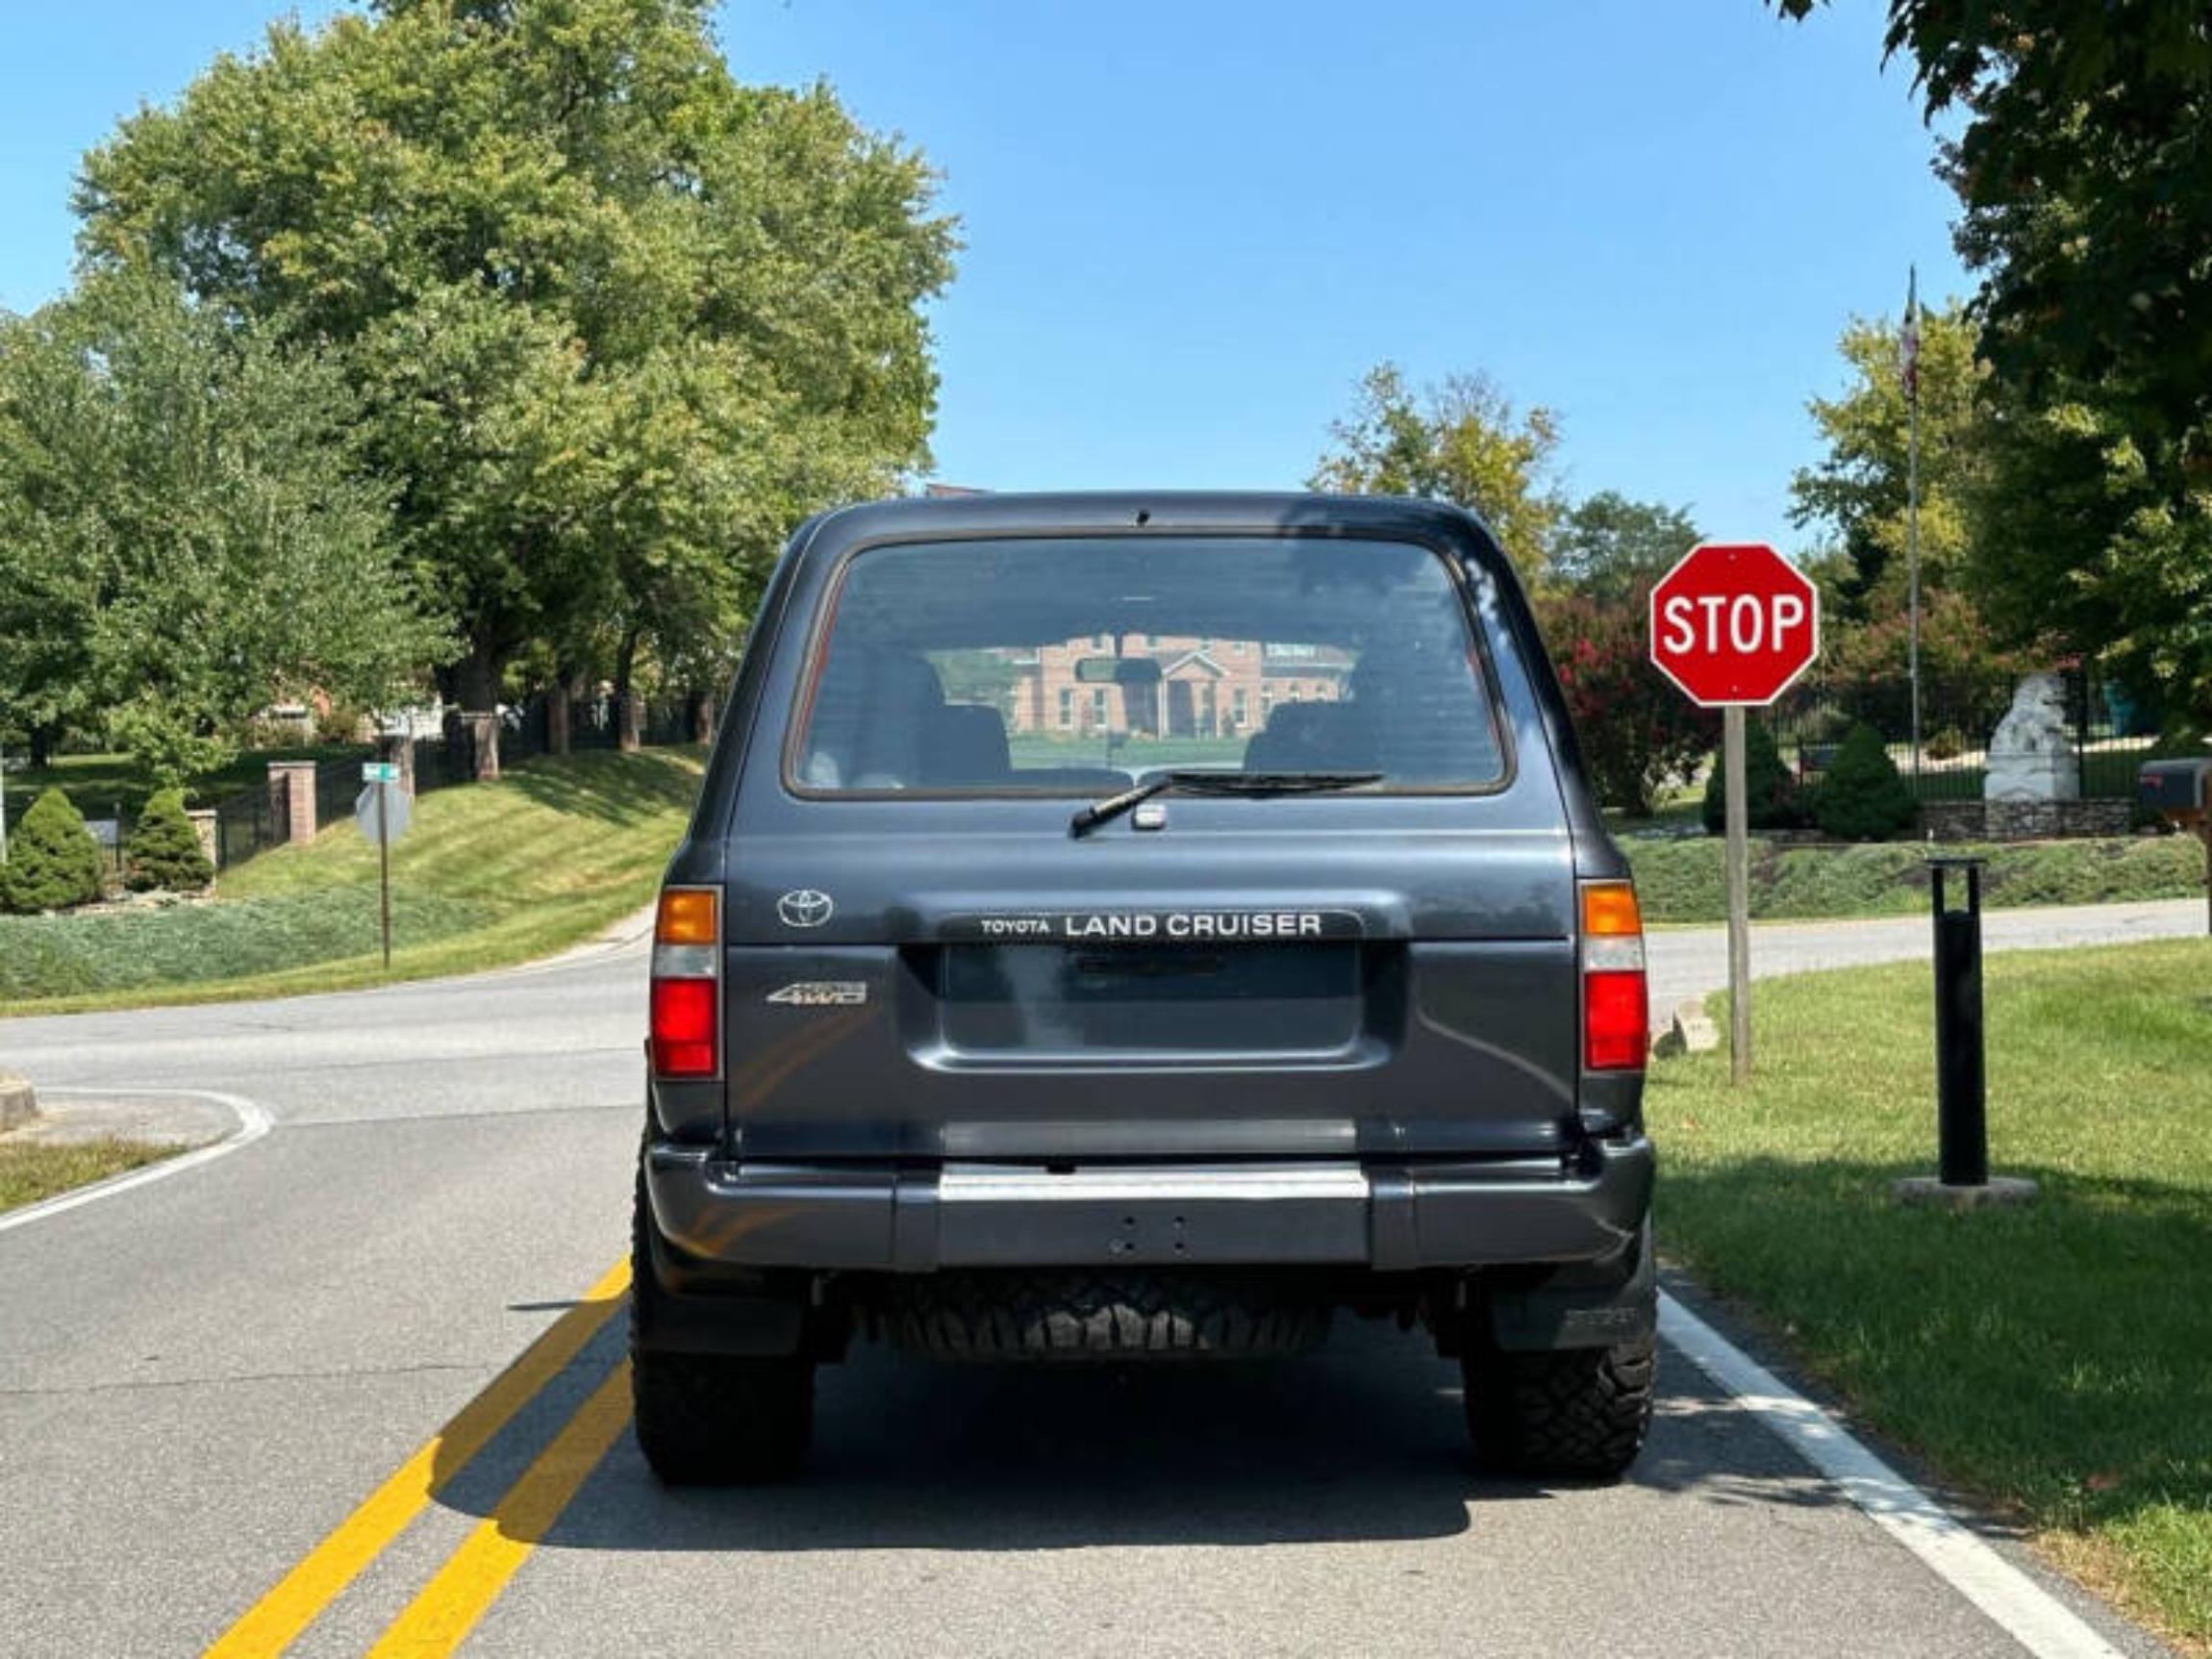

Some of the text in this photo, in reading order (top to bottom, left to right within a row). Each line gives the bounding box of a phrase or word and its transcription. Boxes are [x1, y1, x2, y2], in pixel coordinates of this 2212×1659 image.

[1663, 593, 1804, 655] STOP
[981, 914, 1321, 936] TOYOTA LAND CRUISER
